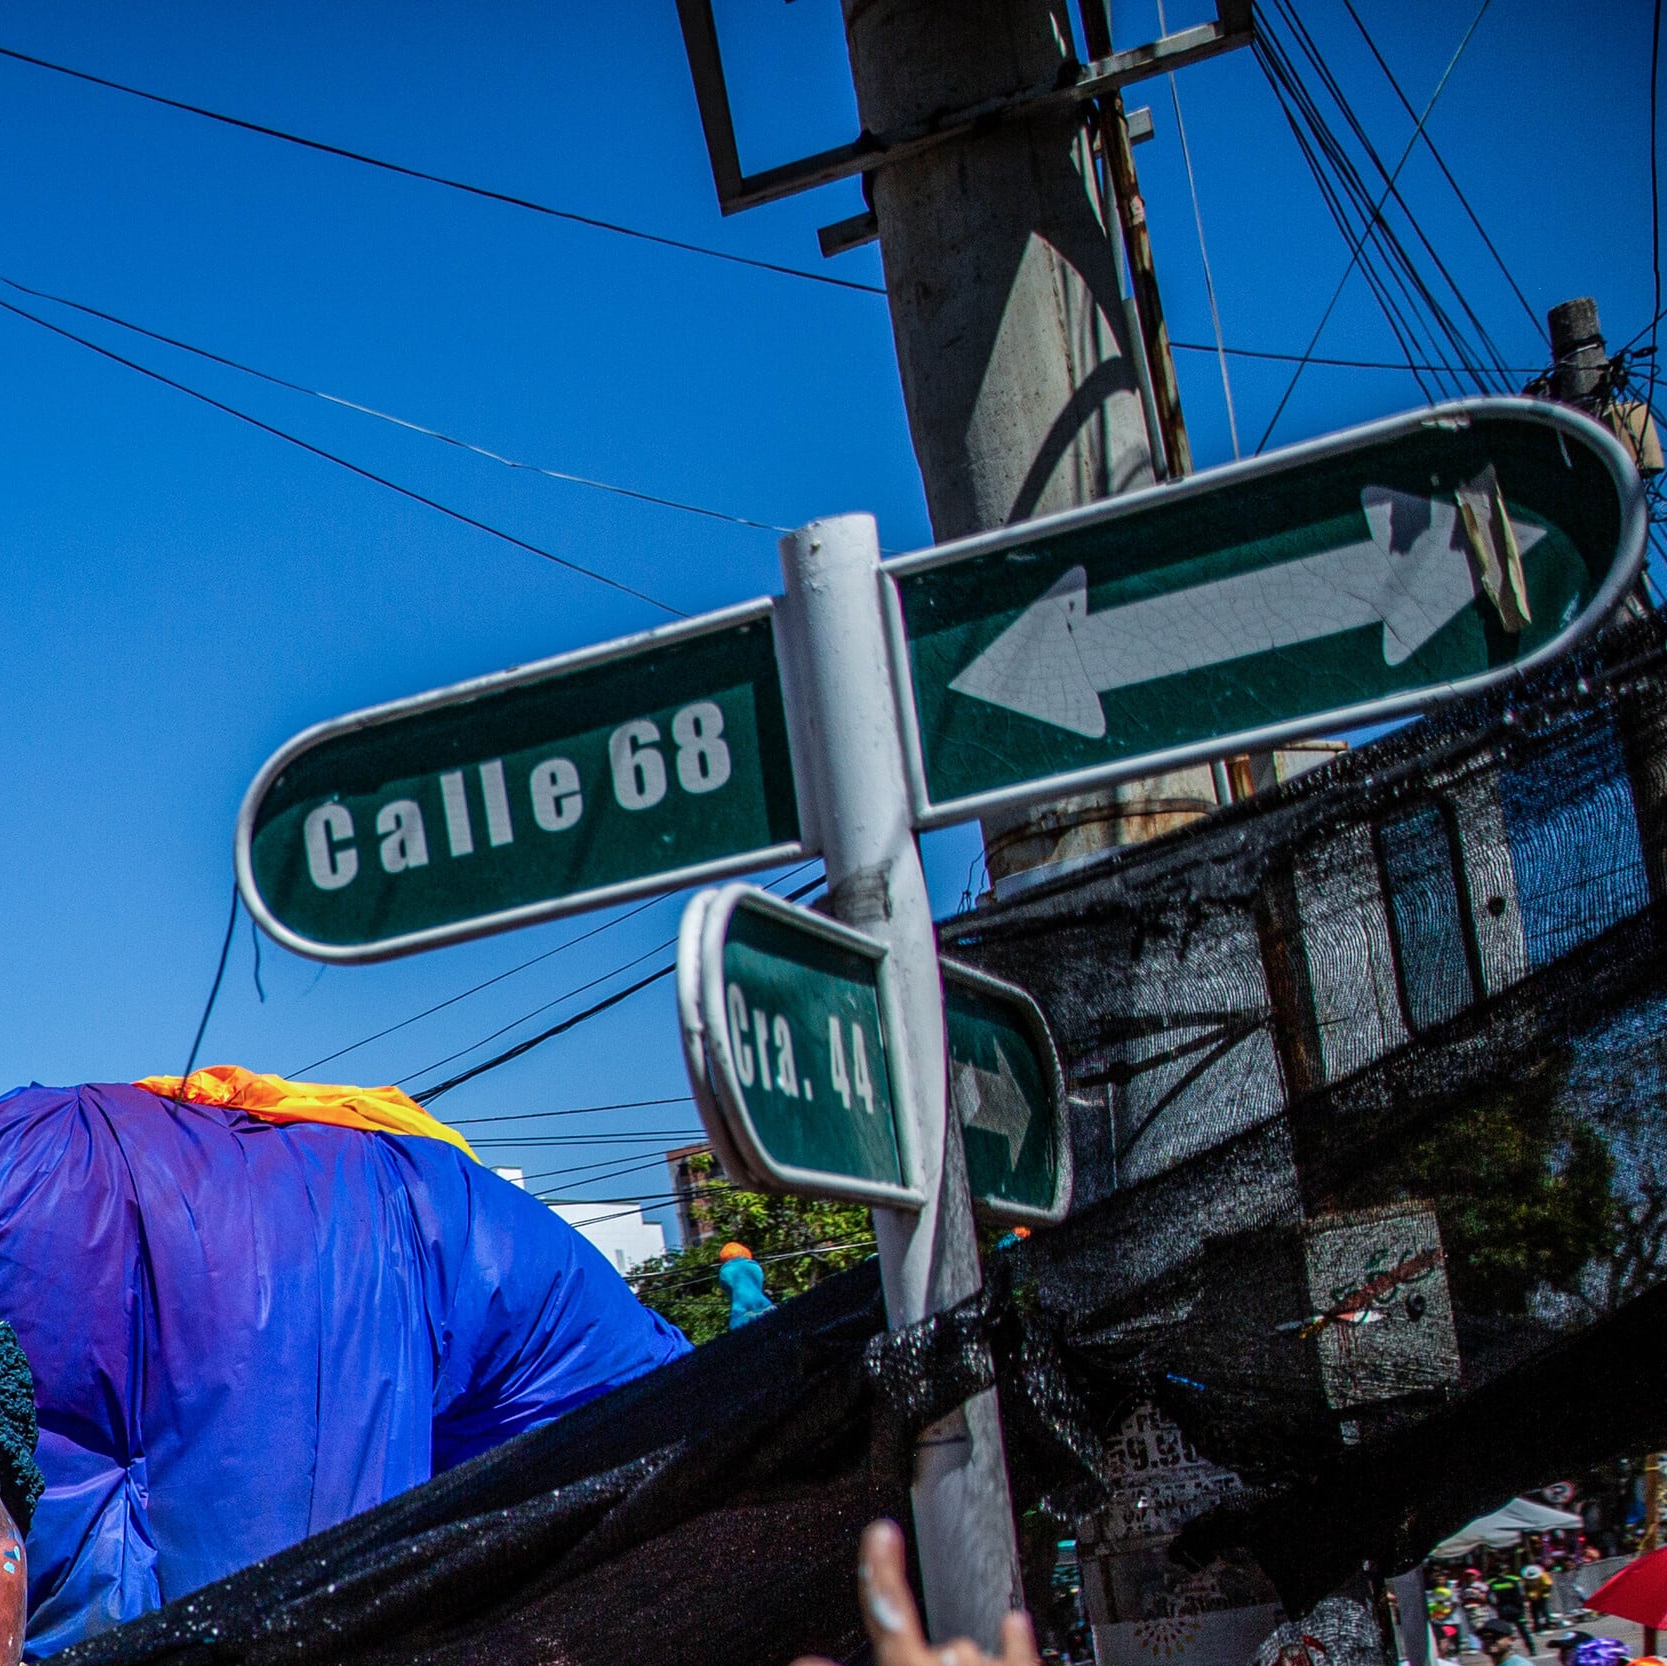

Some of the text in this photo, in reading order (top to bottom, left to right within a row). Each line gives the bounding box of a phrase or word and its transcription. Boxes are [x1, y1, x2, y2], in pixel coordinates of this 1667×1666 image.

[302, 700, 732, 891] Calle 68
[728, 982, 874, 1114] Cra. 44
